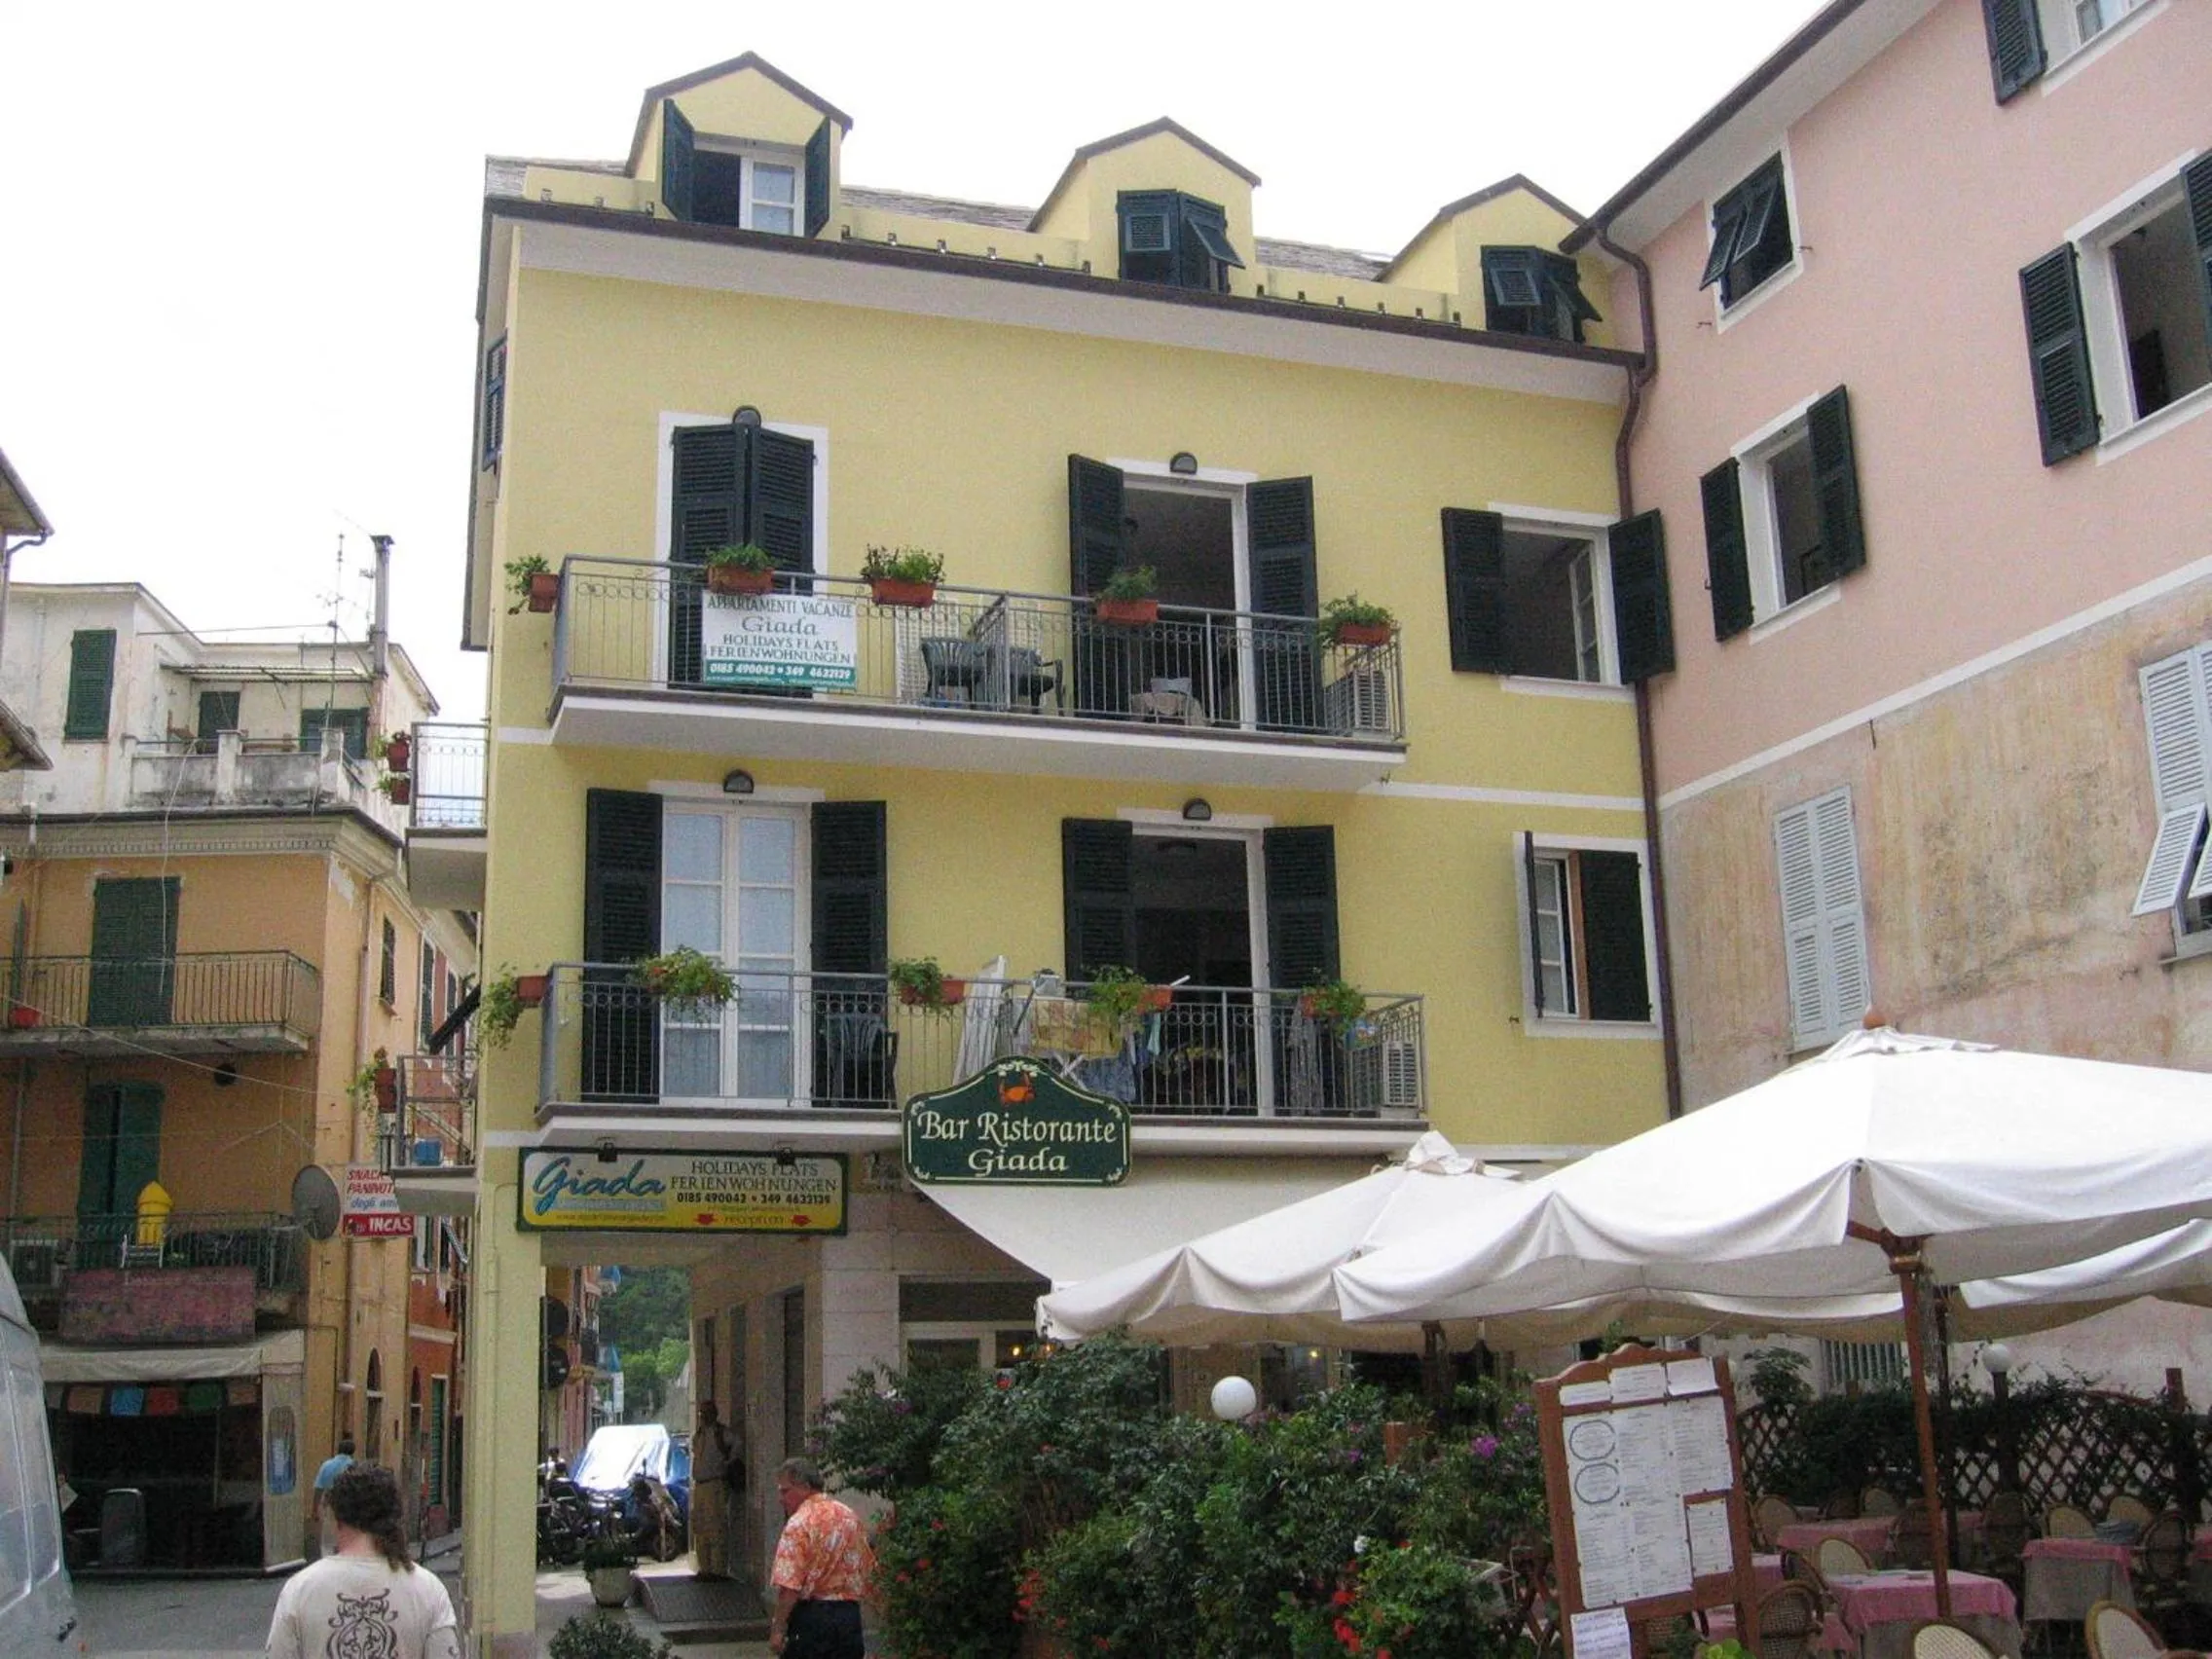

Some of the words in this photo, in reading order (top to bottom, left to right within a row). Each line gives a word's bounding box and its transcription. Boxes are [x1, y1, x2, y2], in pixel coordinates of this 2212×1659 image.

[708, 595, 796, 614] APPARTAMENTI
[801, 601, 853, 617] VACANZE
[741, 615, 818, 635] Giada
[723, 634, 793, 648] HOLIDAYS
[797, 638, 838, 651] FLATS
[710, 645, 851, 664] FERIENWOHNUNGEN
[917, 1111, 970, 1140] Bar
[977, 1112, 1118, 1147] Ristorante
[691, 1160, 768, 1176] HOLIDAYS
[772, 1161, 819, 1177] FLATS
[968, 1147, 1069, 1177] Giada
[533, 1156, 667, 1216] Giada
[671, 1175, 837, 1192] FERIENWOHNUNGEN
[677, 1193, 702, 1203] 0185
[369, 1217, 411, 1233] INCAS
